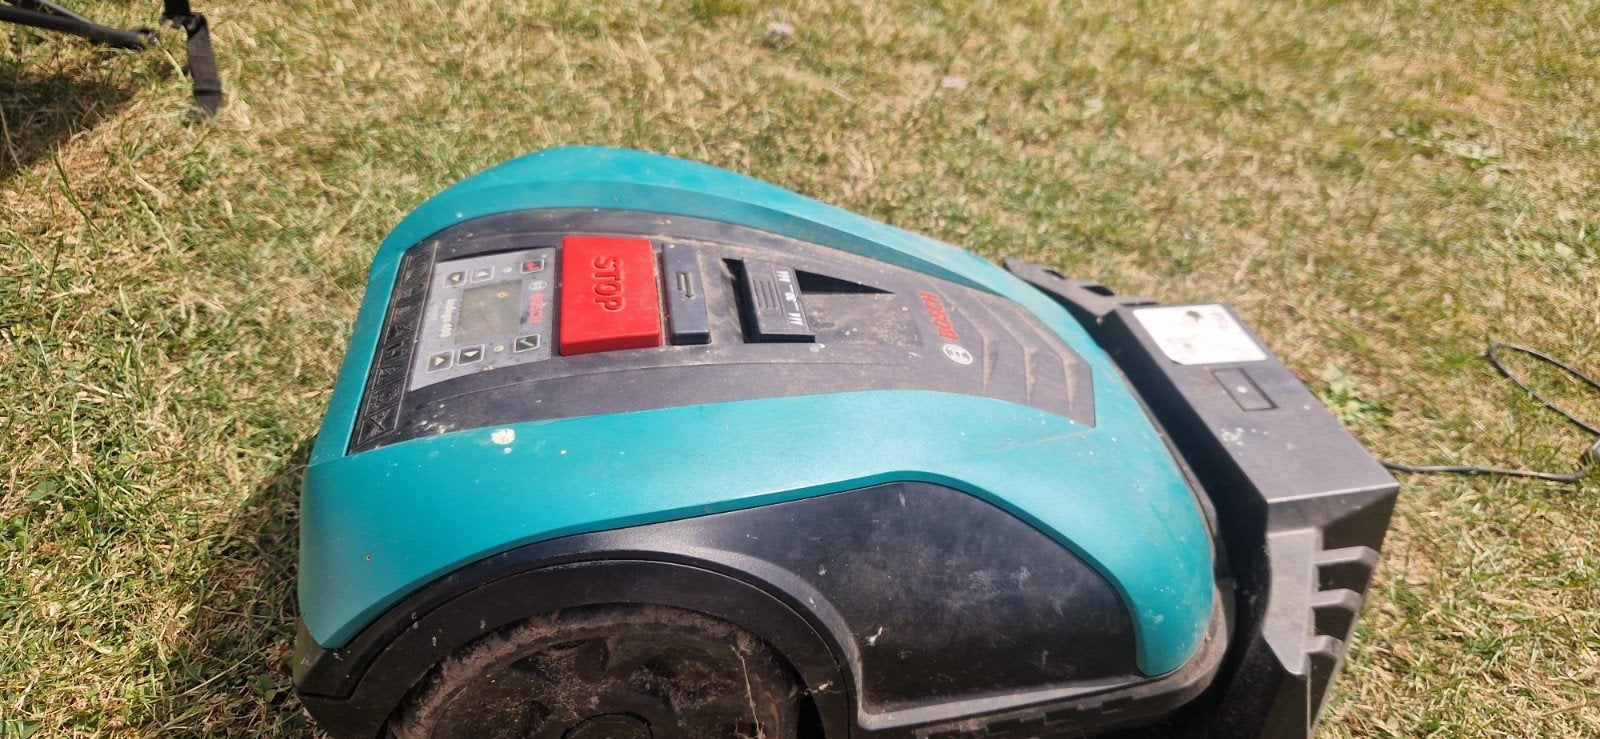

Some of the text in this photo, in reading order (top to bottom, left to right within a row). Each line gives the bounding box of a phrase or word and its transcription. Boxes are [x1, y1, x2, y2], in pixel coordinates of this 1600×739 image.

[594, 256, 624, 311] STOP
[442, 298, 457, 322] Indego
[529, 292, 543, 325] BOSCH
[918, 291, 959, 340] BOSCH
